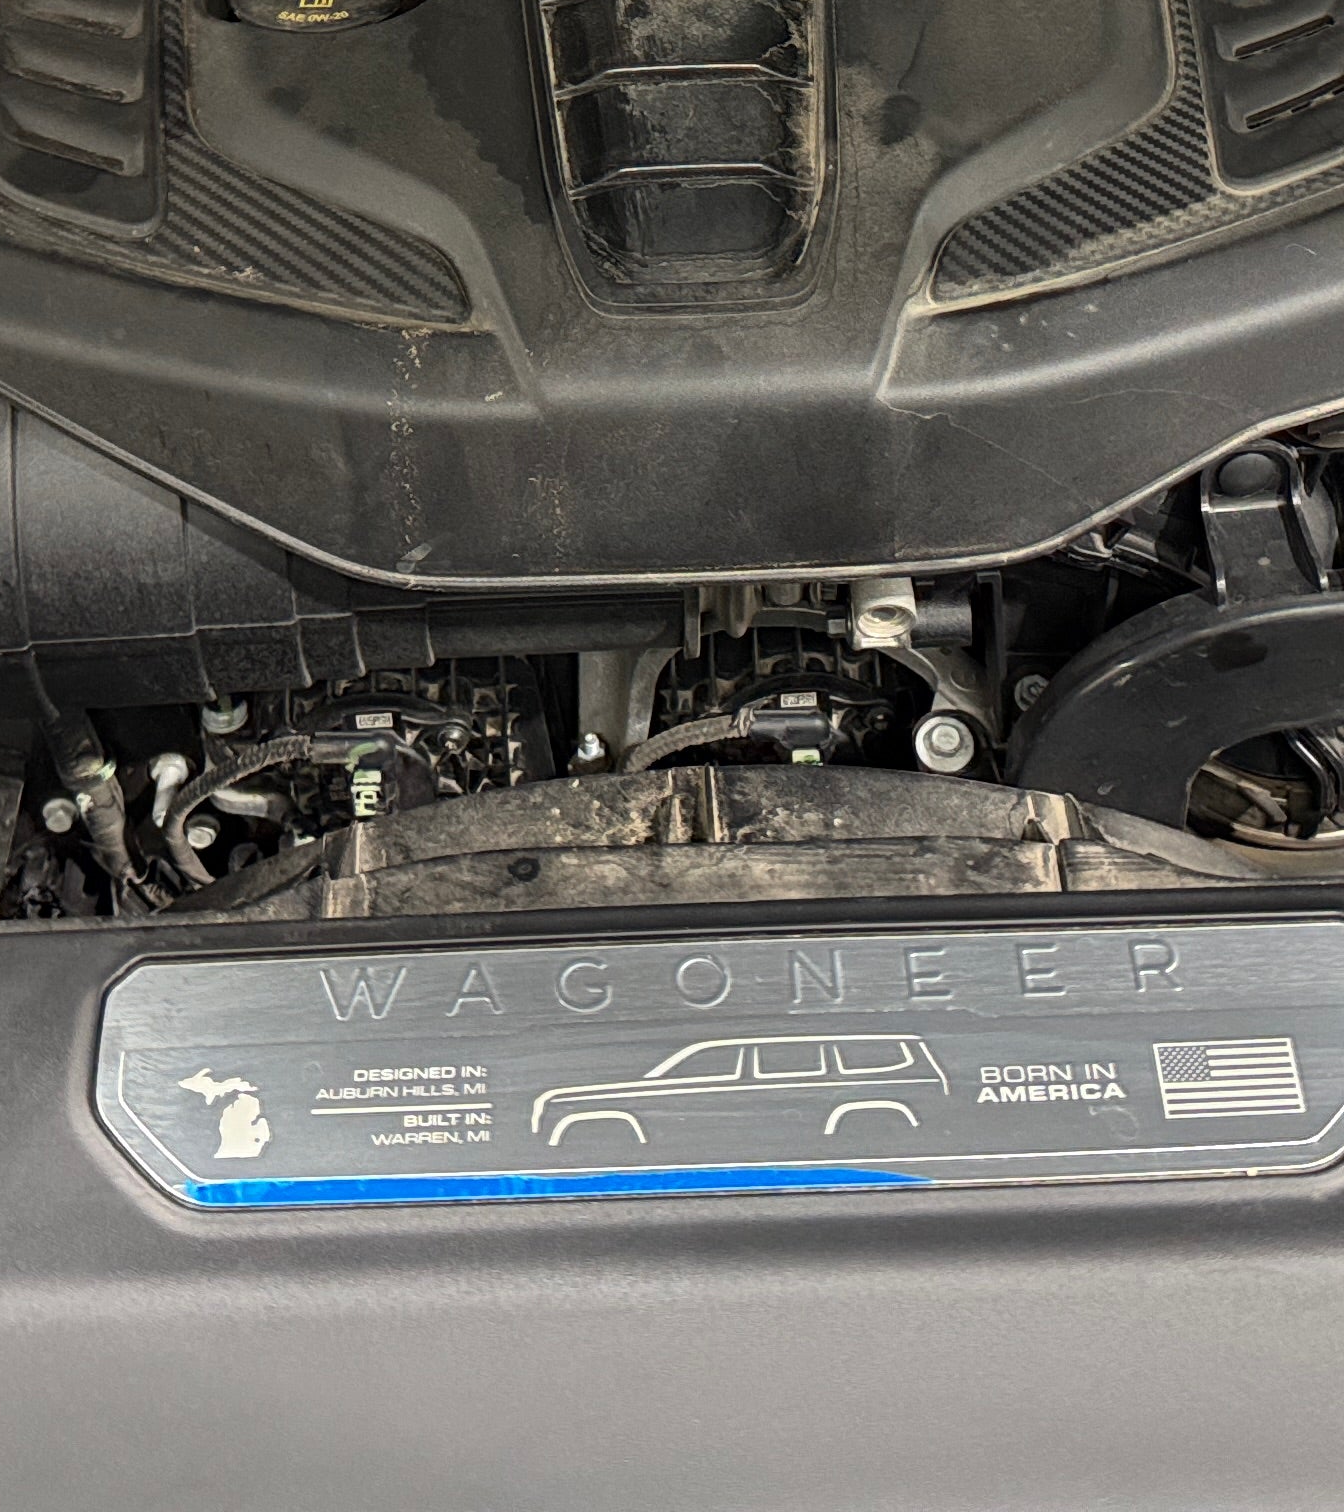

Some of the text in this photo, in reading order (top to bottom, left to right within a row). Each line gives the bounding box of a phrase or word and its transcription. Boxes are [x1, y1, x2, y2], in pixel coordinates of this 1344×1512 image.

[278, 10, 350, 23] SAE 0W-20
[318, 937, 1185, 1022] WAGONEER
[353, 1065, 488, 1083] DESIGNED IN:
[980, 1061, 1118, 1084] BORN IN
[315, 1082, 488, 1101] AUBURN HILLS, MI
[976, 1082, 1128, 1104] AMERICA
[403, 1111, 494, 1128] BUILT IN:
[371, 1130, 491, 1146] WARREN, MI
